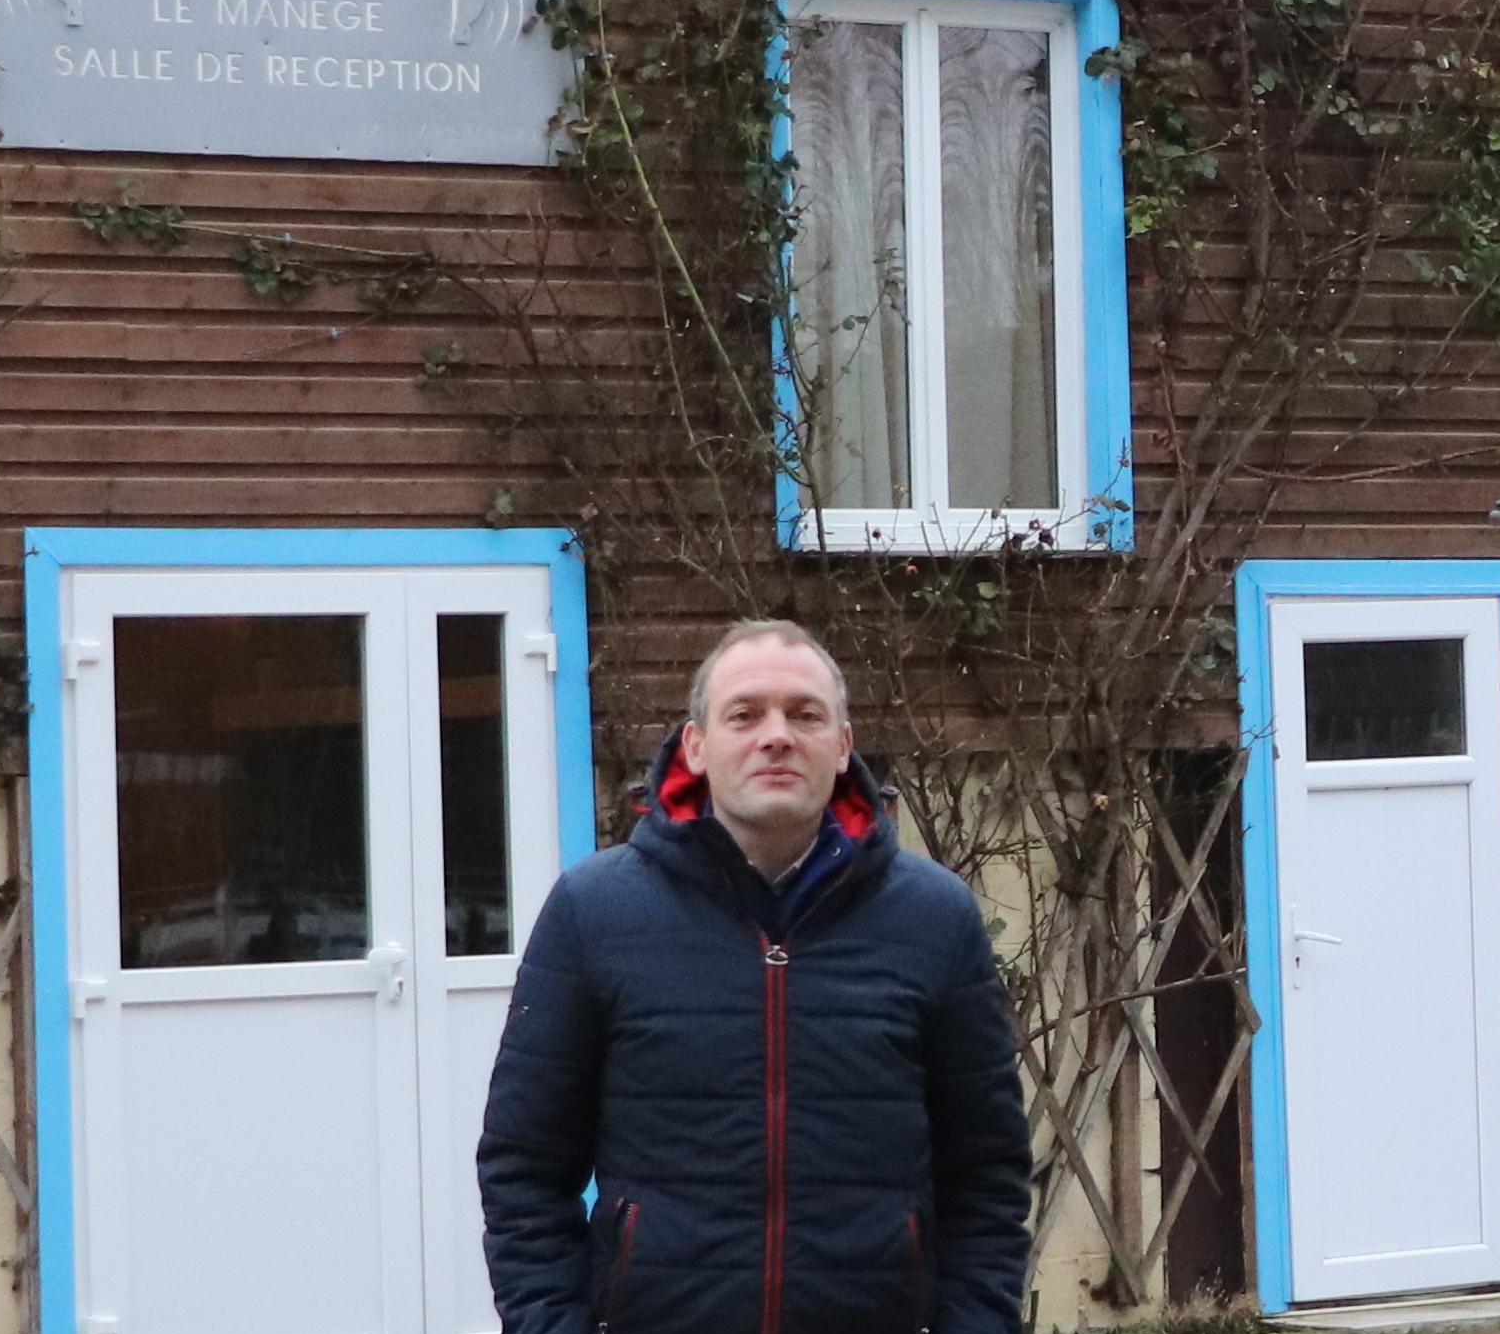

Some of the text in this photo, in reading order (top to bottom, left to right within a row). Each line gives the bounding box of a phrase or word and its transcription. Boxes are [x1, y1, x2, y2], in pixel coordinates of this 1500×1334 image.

[54, 45, 481, 93] SALLE DE RECEPTION
